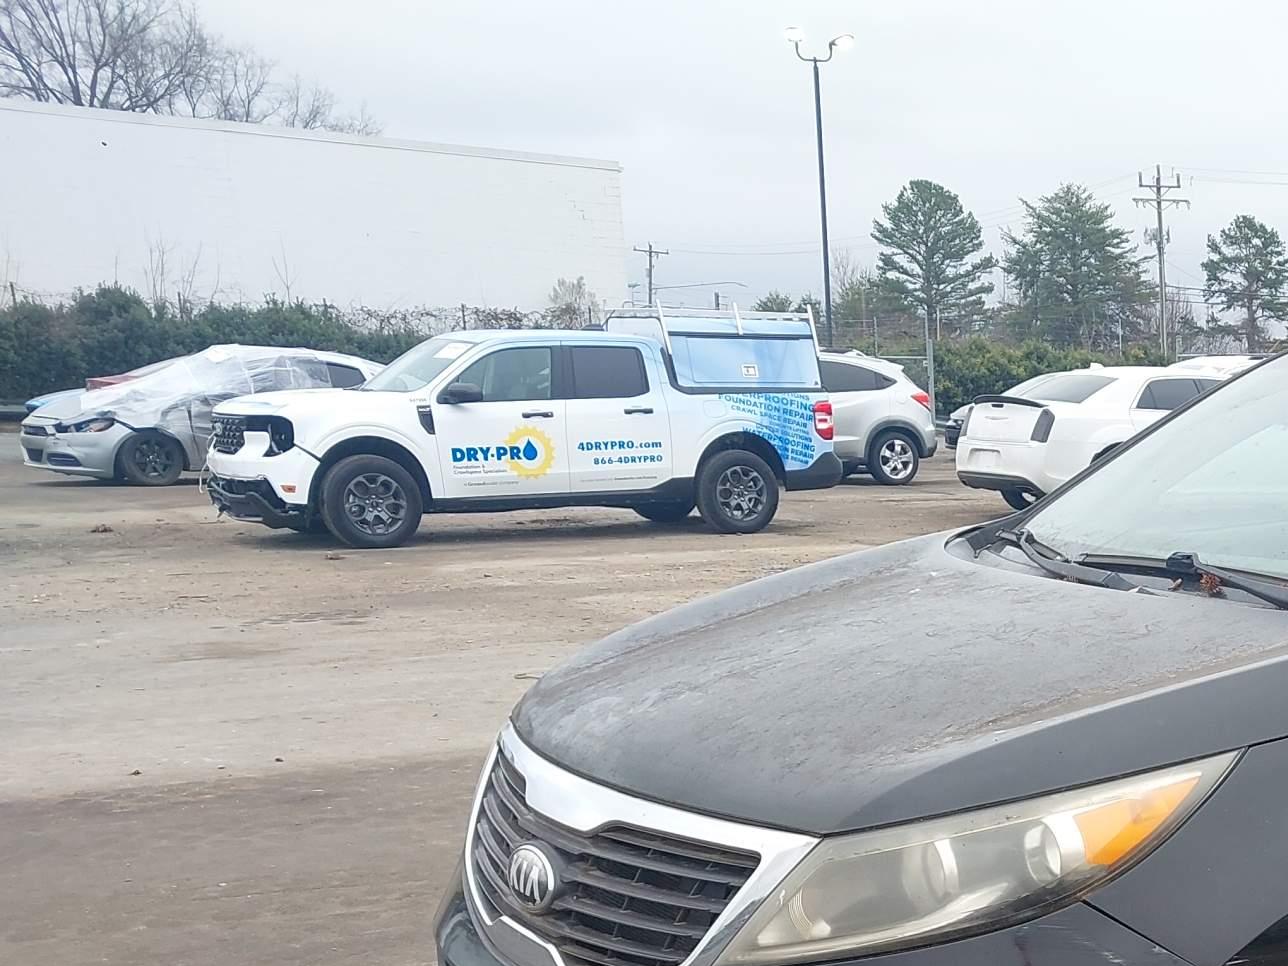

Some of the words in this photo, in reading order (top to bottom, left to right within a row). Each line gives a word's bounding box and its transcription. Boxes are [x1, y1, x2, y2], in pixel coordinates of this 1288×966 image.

[718, 393, 780, 413] FOUNDATION
[783, 407, 813, 422] REPAIR
[577, 440, 662, 451] 4DRYPRO.com
[593, 454, 663, 465] 866-4DRYPRO
